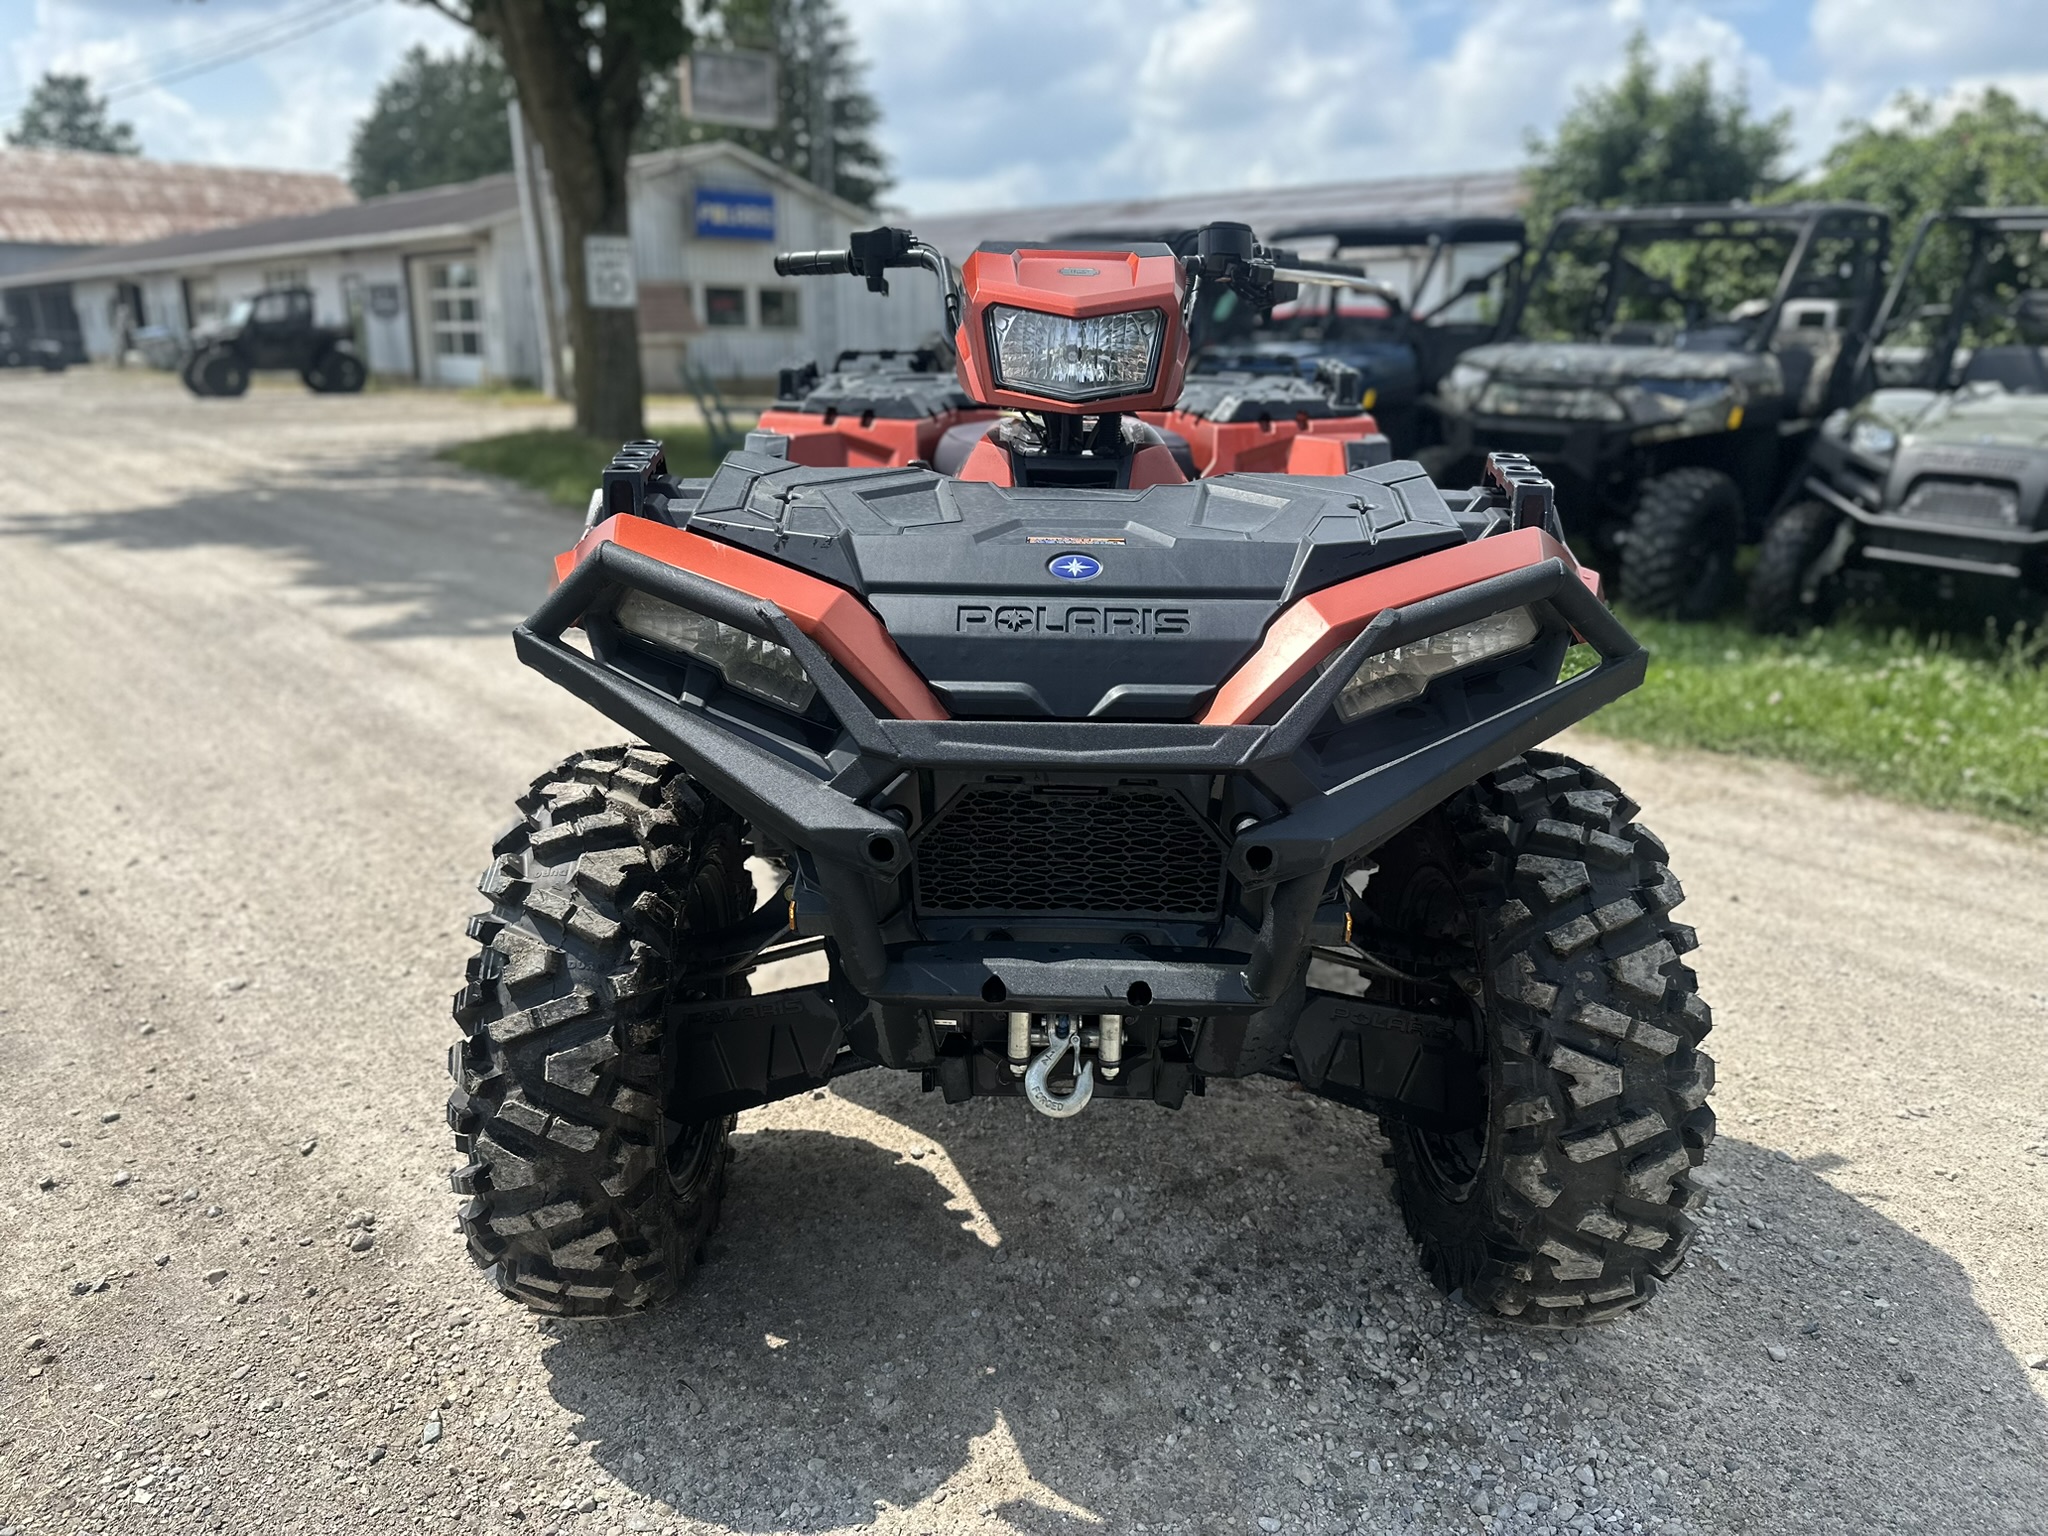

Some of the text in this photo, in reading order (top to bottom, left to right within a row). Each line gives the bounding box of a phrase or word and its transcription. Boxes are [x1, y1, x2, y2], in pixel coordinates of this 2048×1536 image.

[957, 605, 1191, 635] POLARIS
[683, 1000, 805, 1024] POLARIS
[1330, 1008, 1455, 1038] POLARIS
[1032, 1086, 1064, 1112] FORGED
